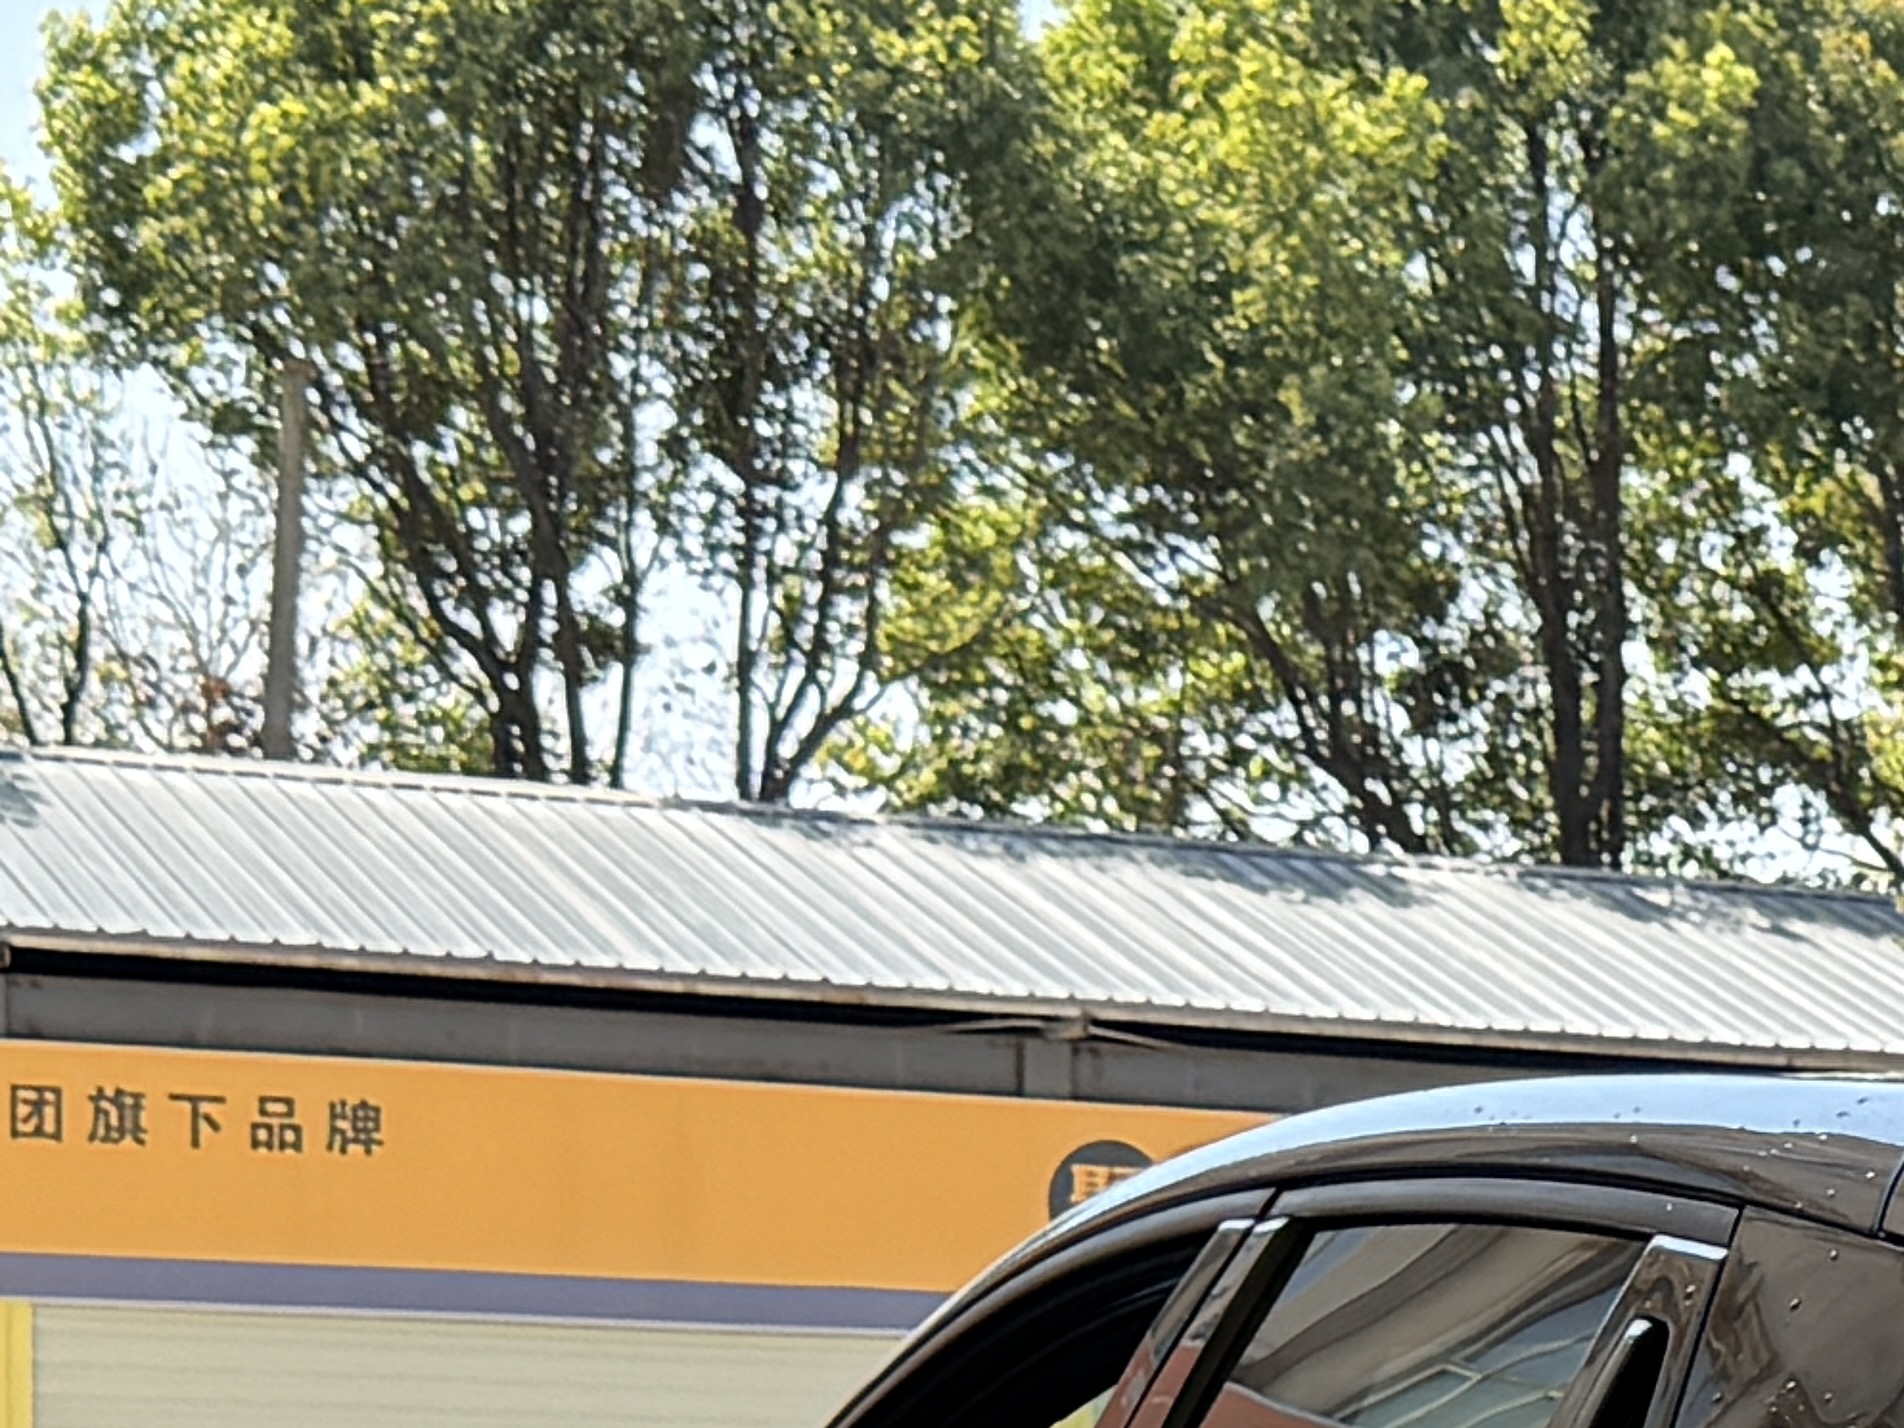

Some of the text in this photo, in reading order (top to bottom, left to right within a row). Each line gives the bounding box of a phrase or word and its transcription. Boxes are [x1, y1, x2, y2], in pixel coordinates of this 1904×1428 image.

[10, 1083, 384, 1156] 团旗下品牌
